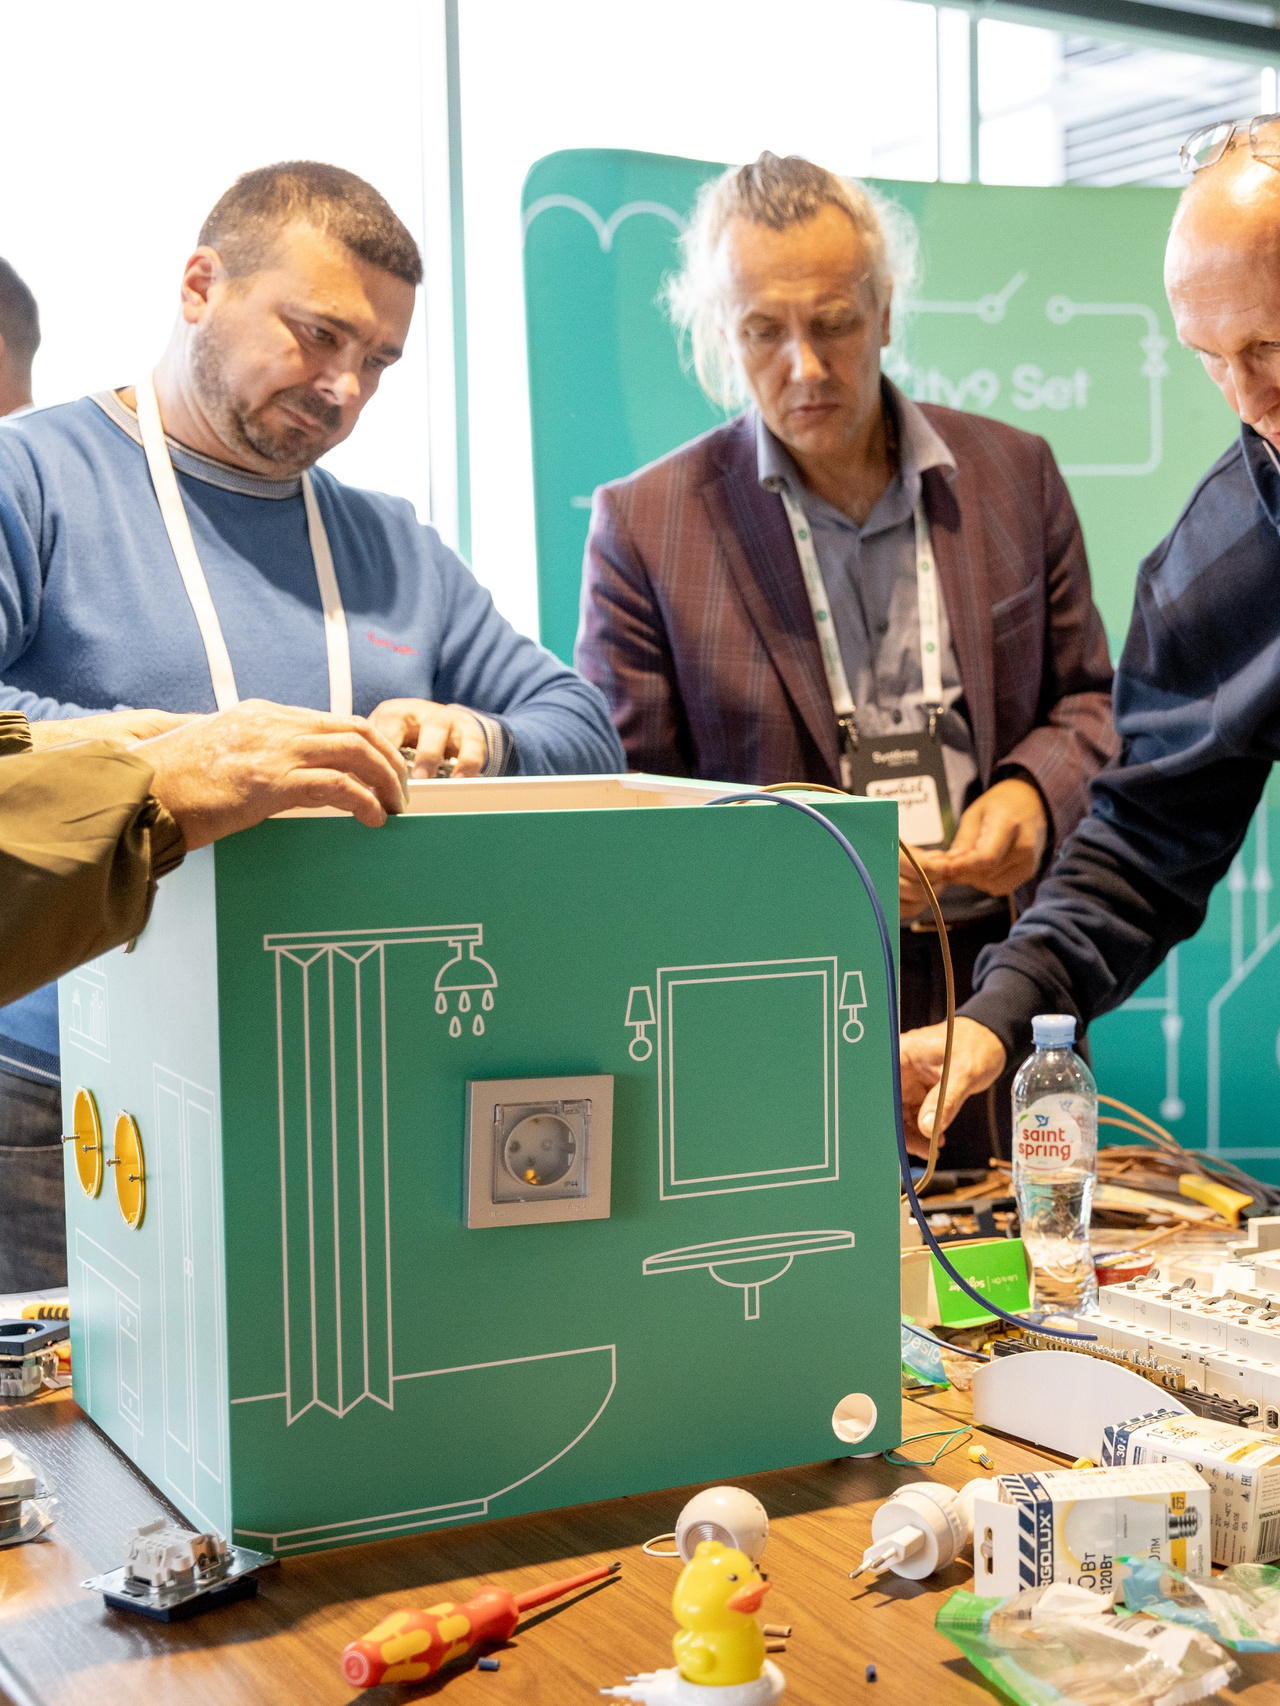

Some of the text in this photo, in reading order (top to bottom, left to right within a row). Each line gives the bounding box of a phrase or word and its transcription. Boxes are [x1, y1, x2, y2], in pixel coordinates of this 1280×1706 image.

[910, 363, 1089, 411] ity9 Set
[1018, 1143, 1071, 1161] spring
[1022, 1127, 1066, 1142] saint
[901, 1327, 941, 1365] Desig
[1116, 1444, 1126, 1458] 30
[1040, 1513, 1052, 1587] RGOLUX
[1100, 1554, 1112, 1594] 120Вт
